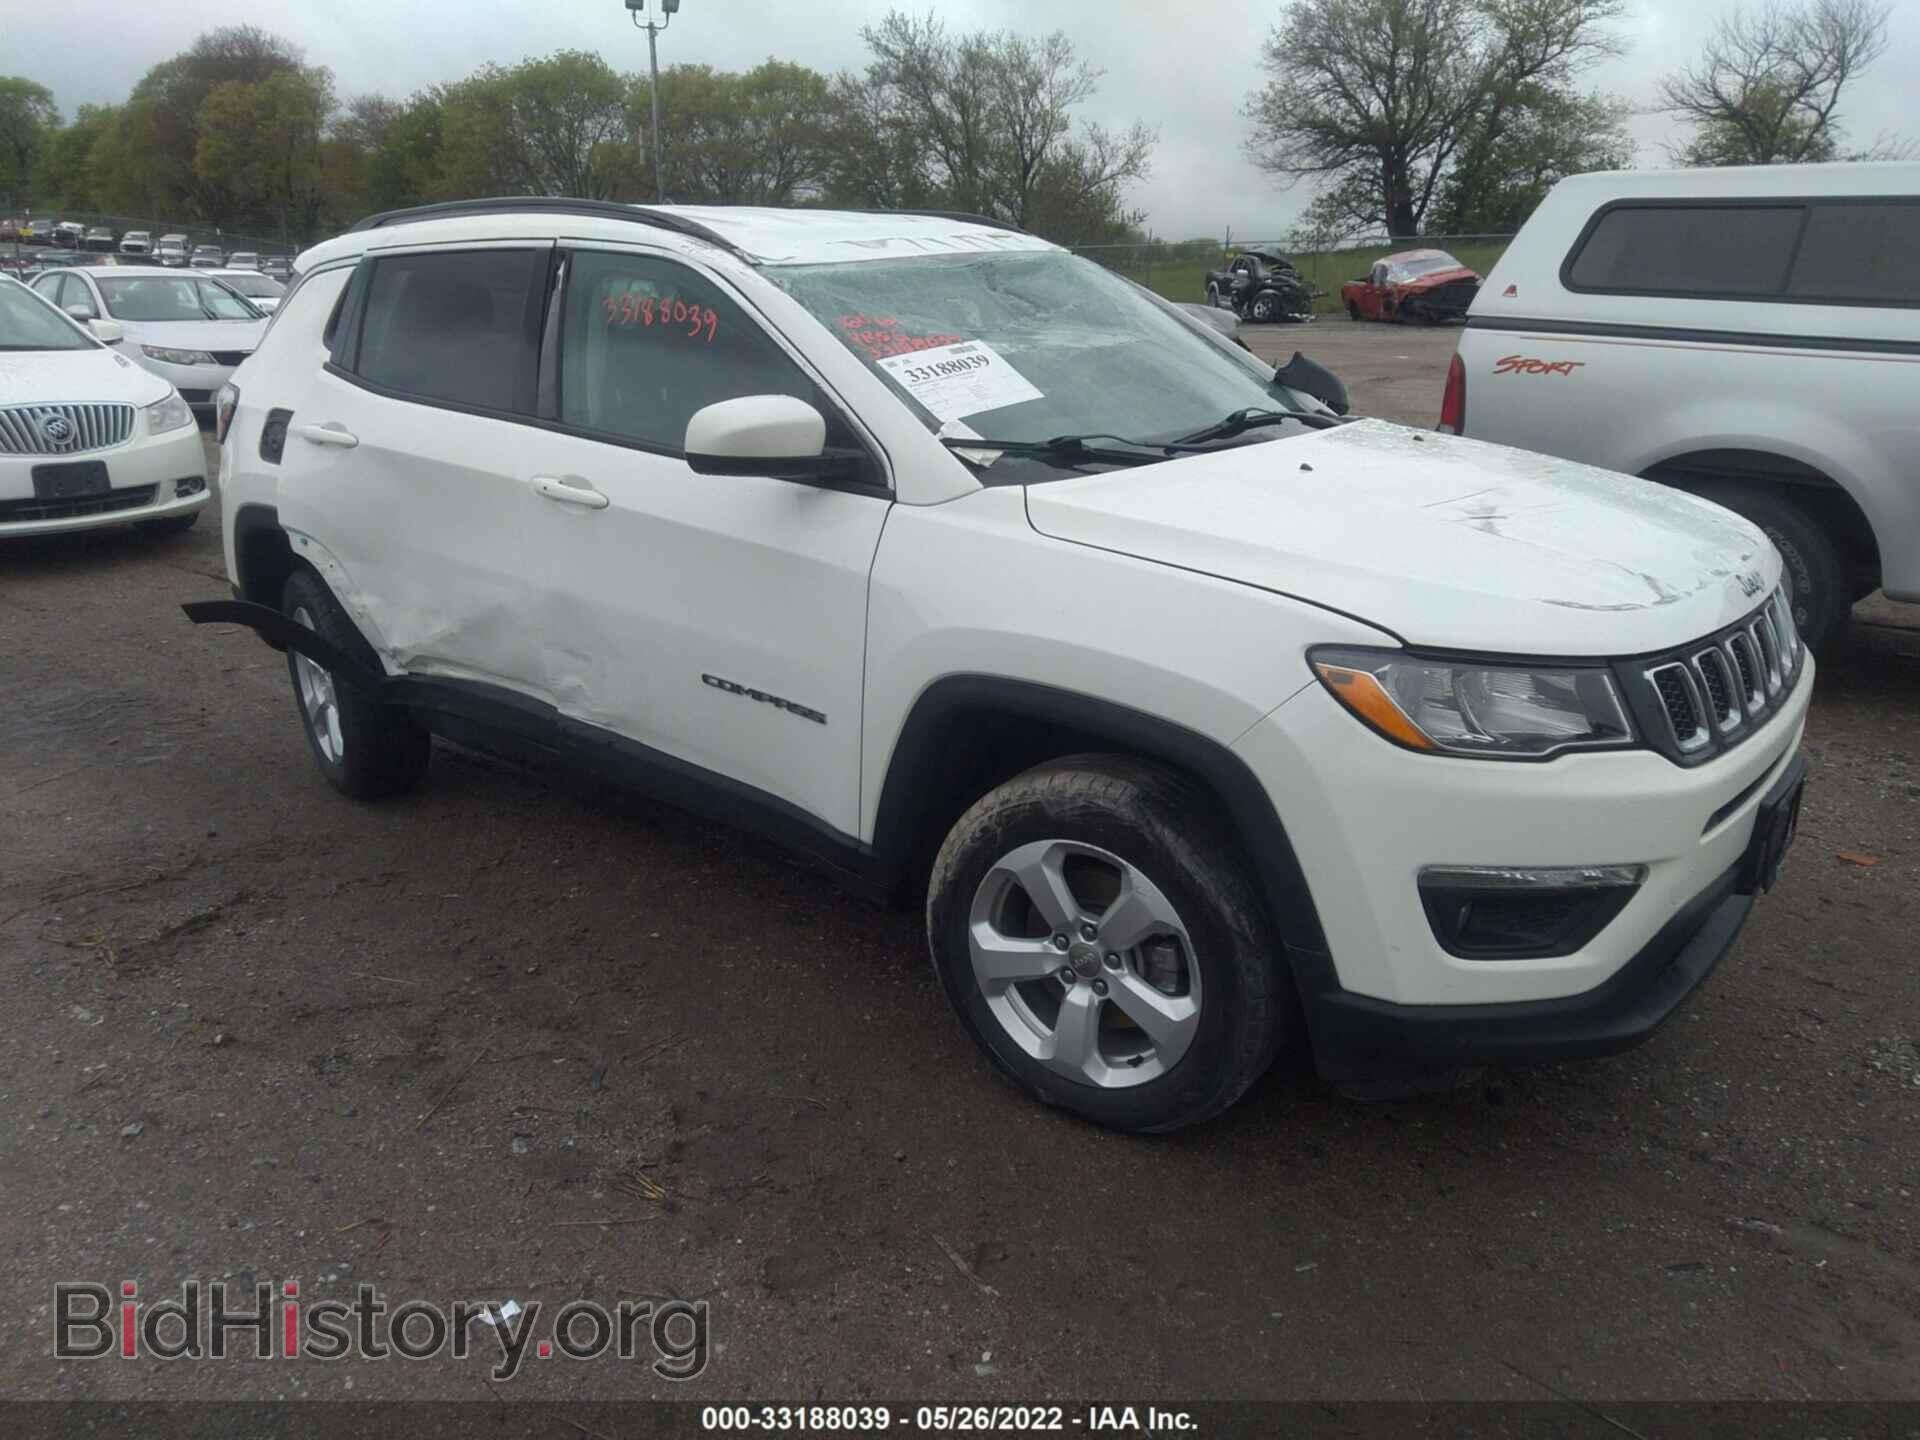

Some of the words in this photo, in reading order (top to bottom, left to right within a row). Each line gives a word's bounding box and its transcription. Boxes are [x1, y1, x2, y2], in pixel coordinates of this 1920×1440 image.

[602, 293, 719, 343] 33188039
[903, 353, 991, 383] 33188039
[1492, 354, 1586, 377] SPORT
[701, 673, 828, 726] COMPASS
